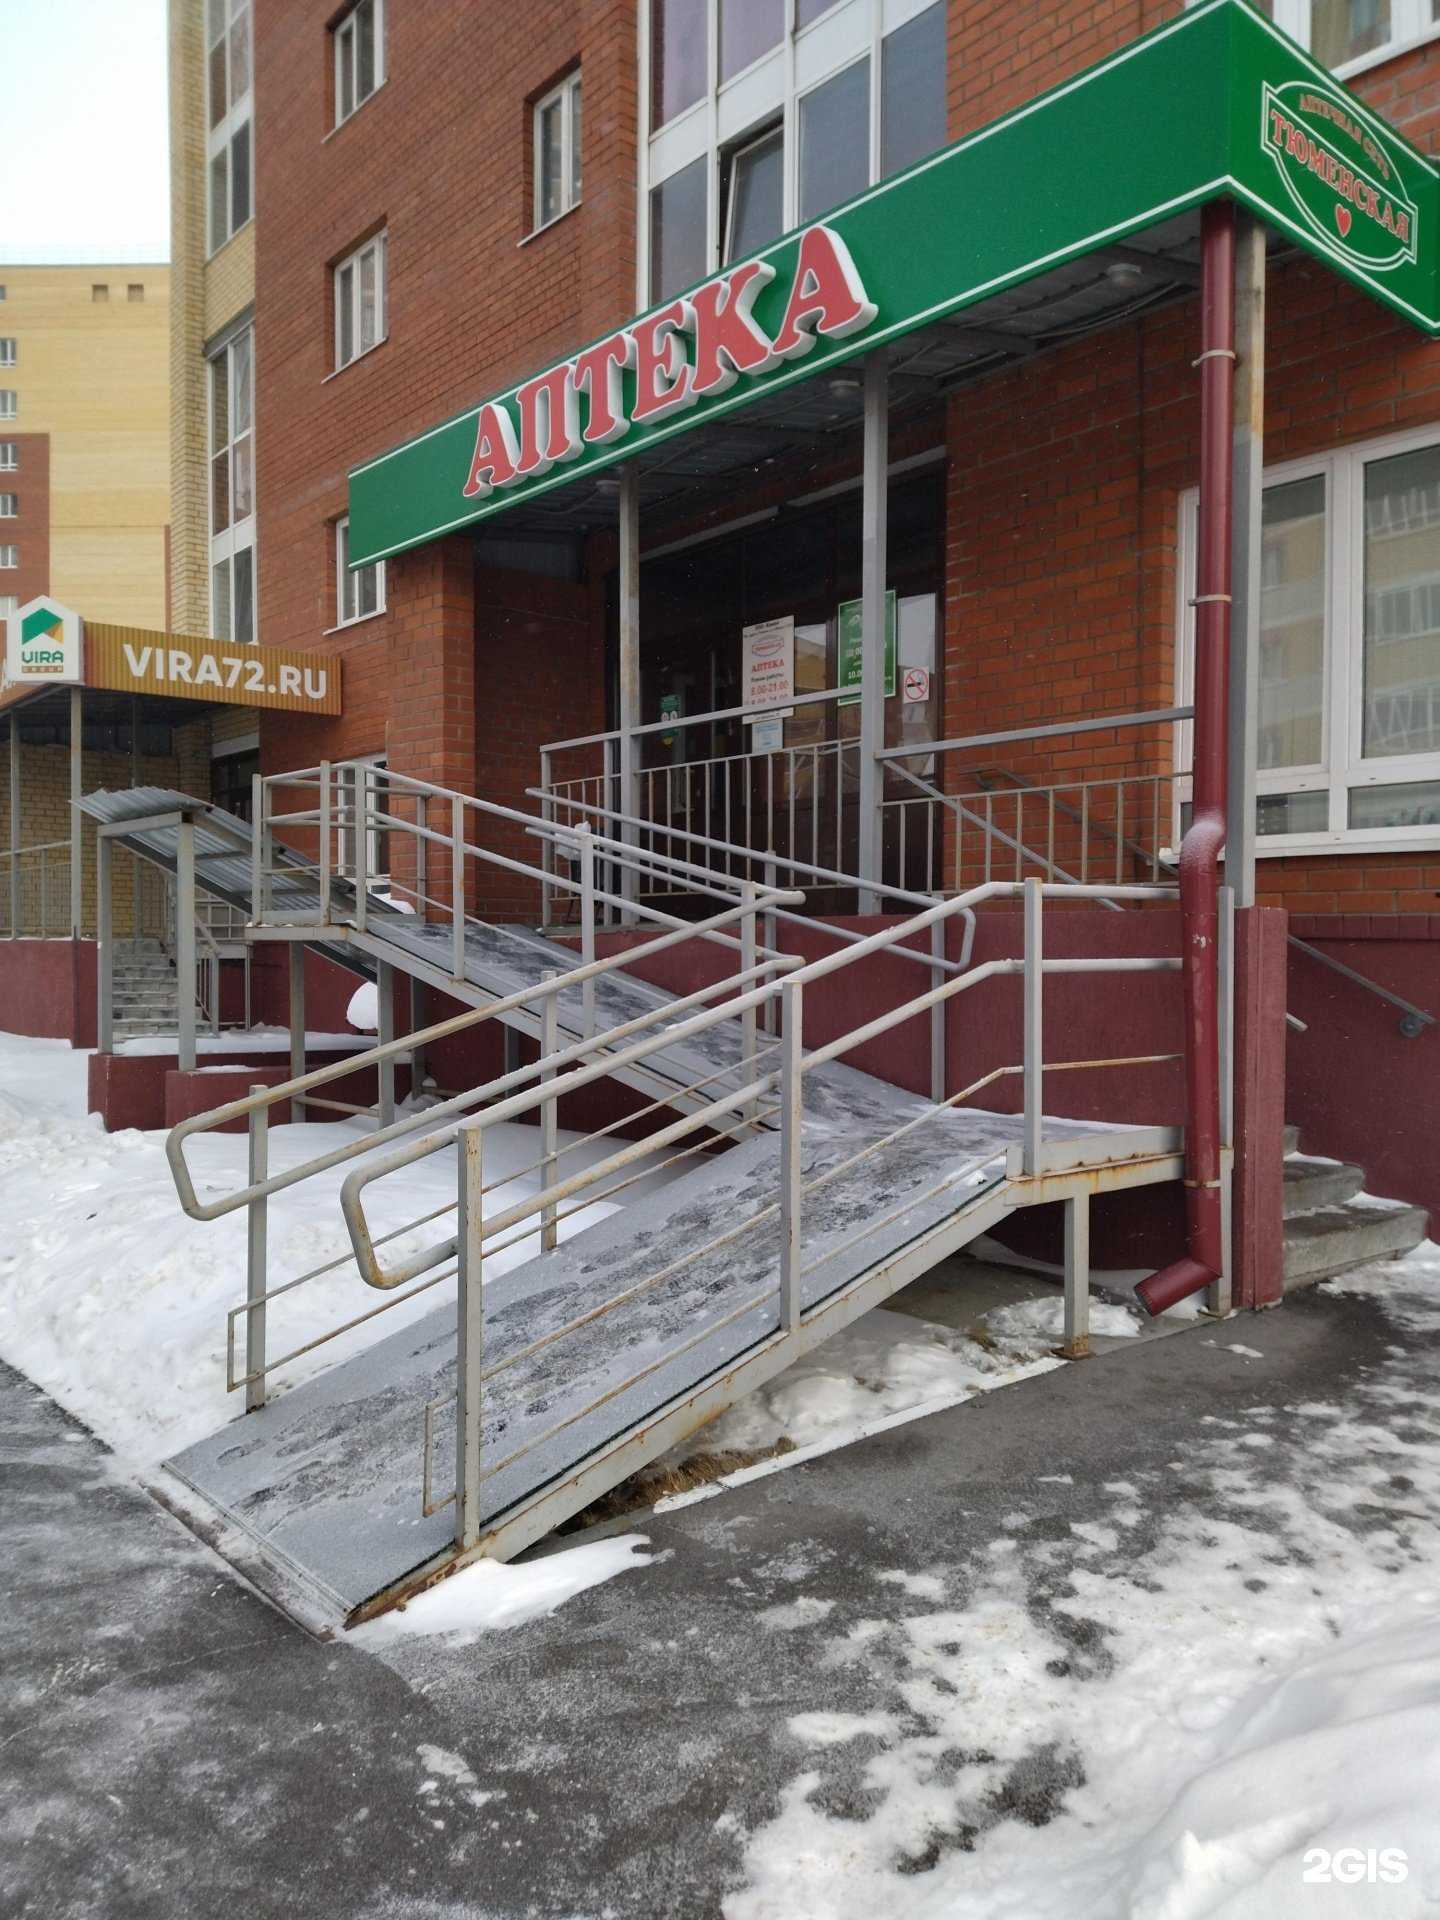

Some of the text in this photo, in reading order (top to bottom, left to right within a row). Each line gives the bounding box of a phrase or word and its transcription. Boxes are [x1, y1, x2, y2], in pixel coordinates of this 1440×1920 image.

[1269, 108, 1410, 244] ТЮМЕНСКАЯ
[462, 224, 879, 500] АПТЕКА
[21, 650, 64, 664] VIRA
[122, 643, 328, 700] VIRA72.RU
[751, 658, 785, 673] АПТЕКА
